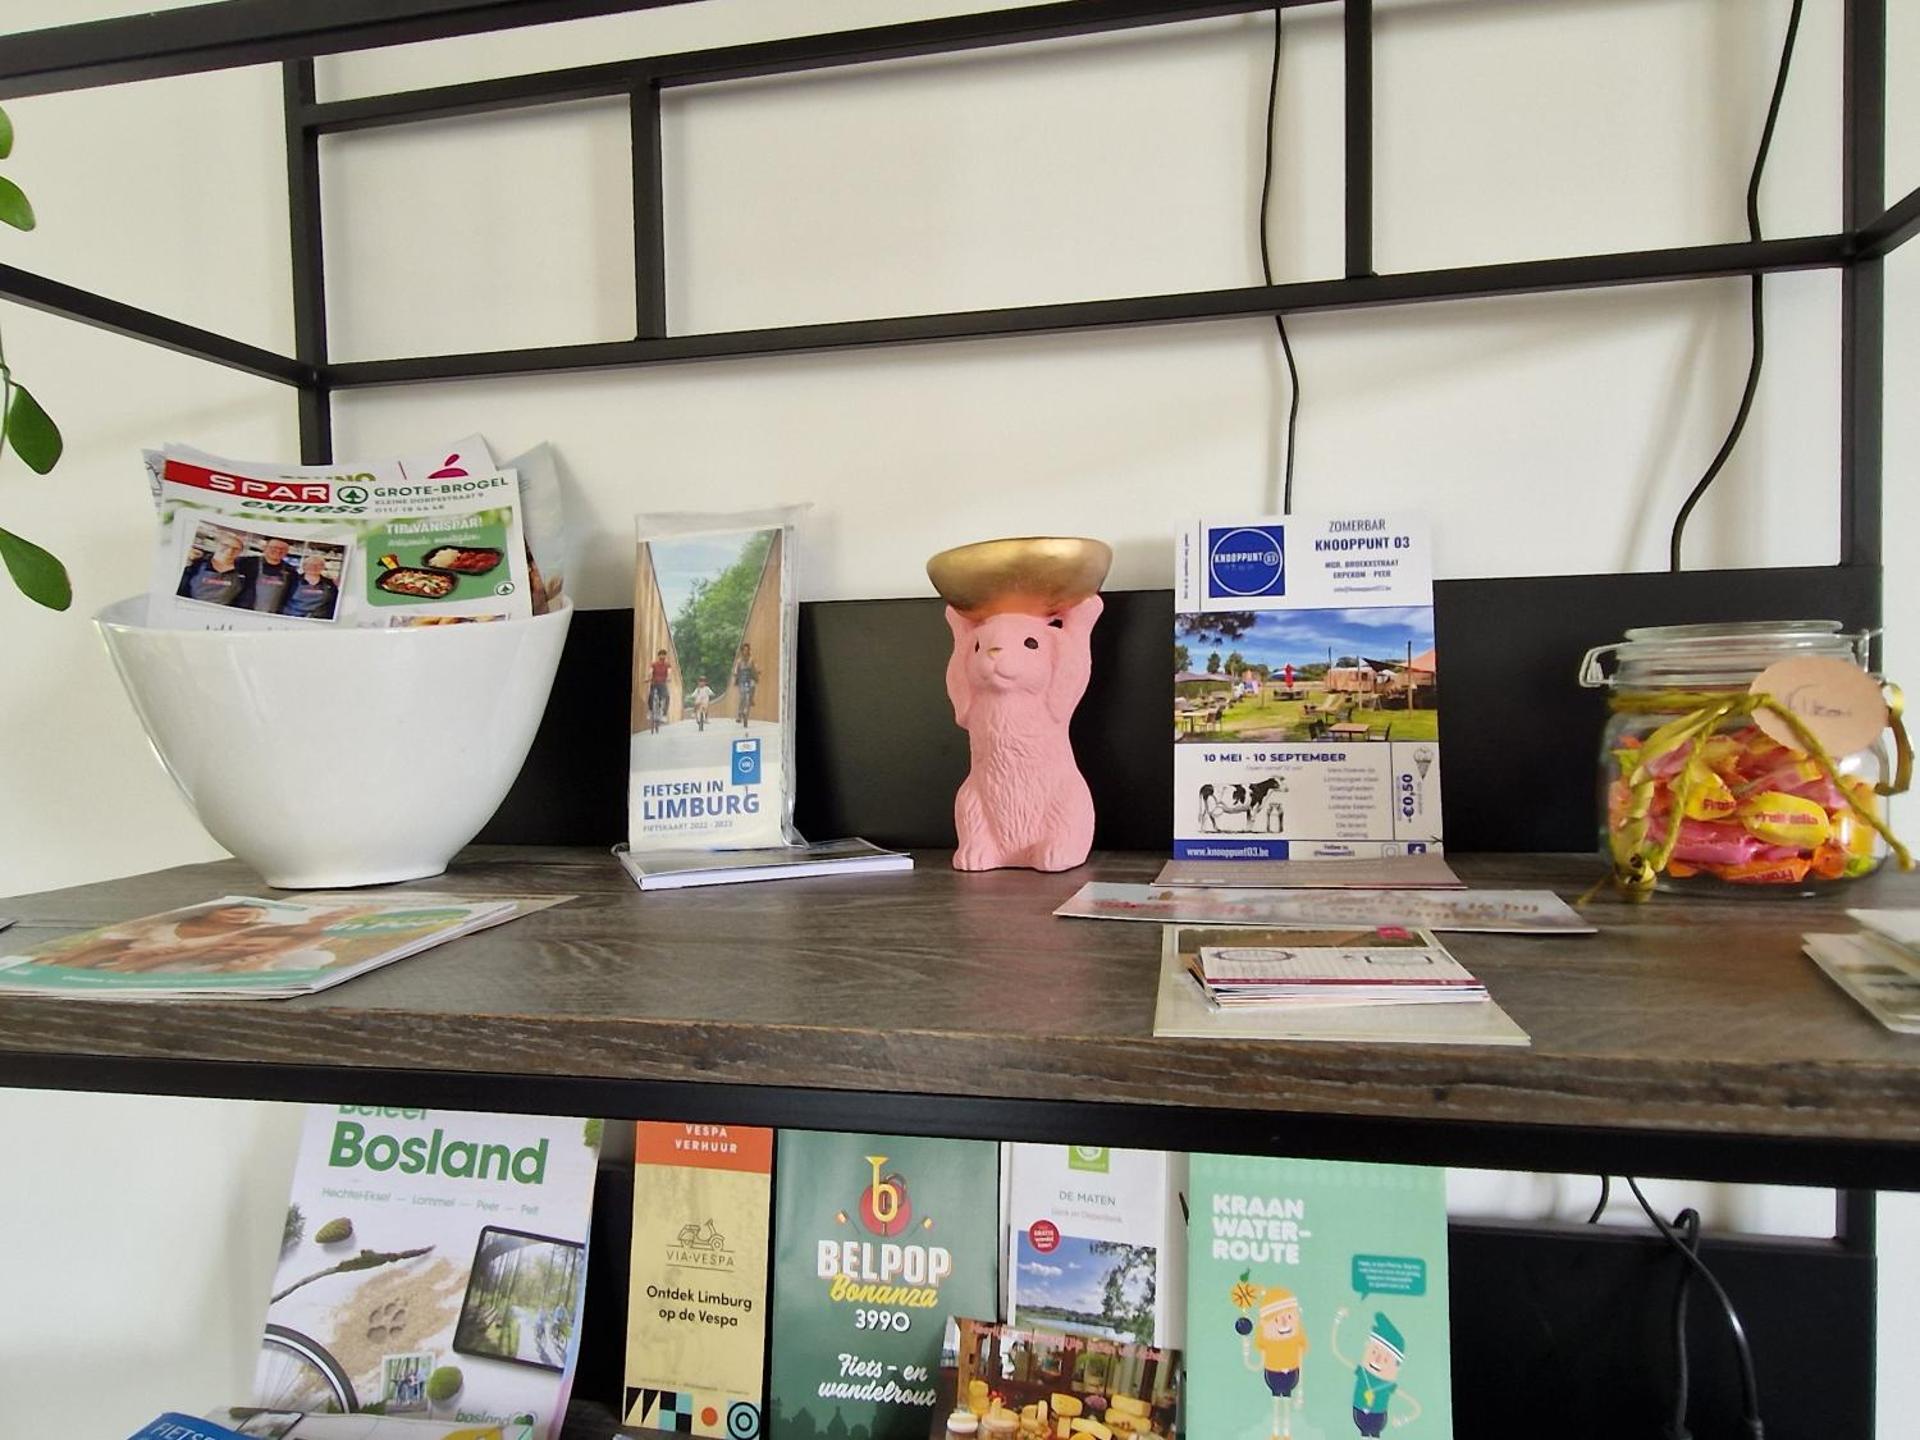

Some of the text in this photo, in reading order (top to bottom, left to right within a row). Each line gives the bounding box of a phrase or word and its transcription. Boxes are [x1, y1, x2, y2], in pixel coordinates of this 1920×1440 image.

[208, 473, 328, 500] SPAR
[374, 478, 509, 497] GROTE-BROGEL
[241, 501, 367, 514] express
[1329, 519, 1386, 533] ZOMERBAR
[1315, 536, 1410, 551] KNOOPPUNT 03
[1215, 552, 1263, 563] KNOOPPUNT
[1204, 754, 1216, 762] 10
[1220, 754, 1242, 762] MEI
[1254, 753, 1266, 761] 10
[1270, 753, 1346, 762] SEPTEMBER
[643, 780, 724, 797] FIETSEN IN
[643, 793, 760, 820] LIMBURG
[1187, 847, 1269, 858] www.knooppunt03.be
[685, 1124, 727, 1138] VESPA
[328, 1121, 550, 1185] Bosland
[675, 1139, 738, 1154] VERHUUR
[412, 1195, 456, 1207] Lommel
[476, 1201, 499, 1212] Peer
[521, 1204, 540, 1214] Pelt
[1059, 1190, 1116, 1206] DE MATEN
[1213, 1194, 1304, 1220] KRAAN
[1212, 1216, 1312, 1242] WATER-
[1213, 1239, 1300, 1265] ROUTE
[817, 1239, 951, 1287] BELPOP
[647, 1285, 752, 1312] Ontdek Limburg
[830, 1272, 938, 1308] Bonanza
[659, 1308, 738, 1328] op de Vespa
[855, 1308, 911, 1332] 3990
[838, 1353, 882, 1377] Fiets
[903, 1365, 928, 1382] en
